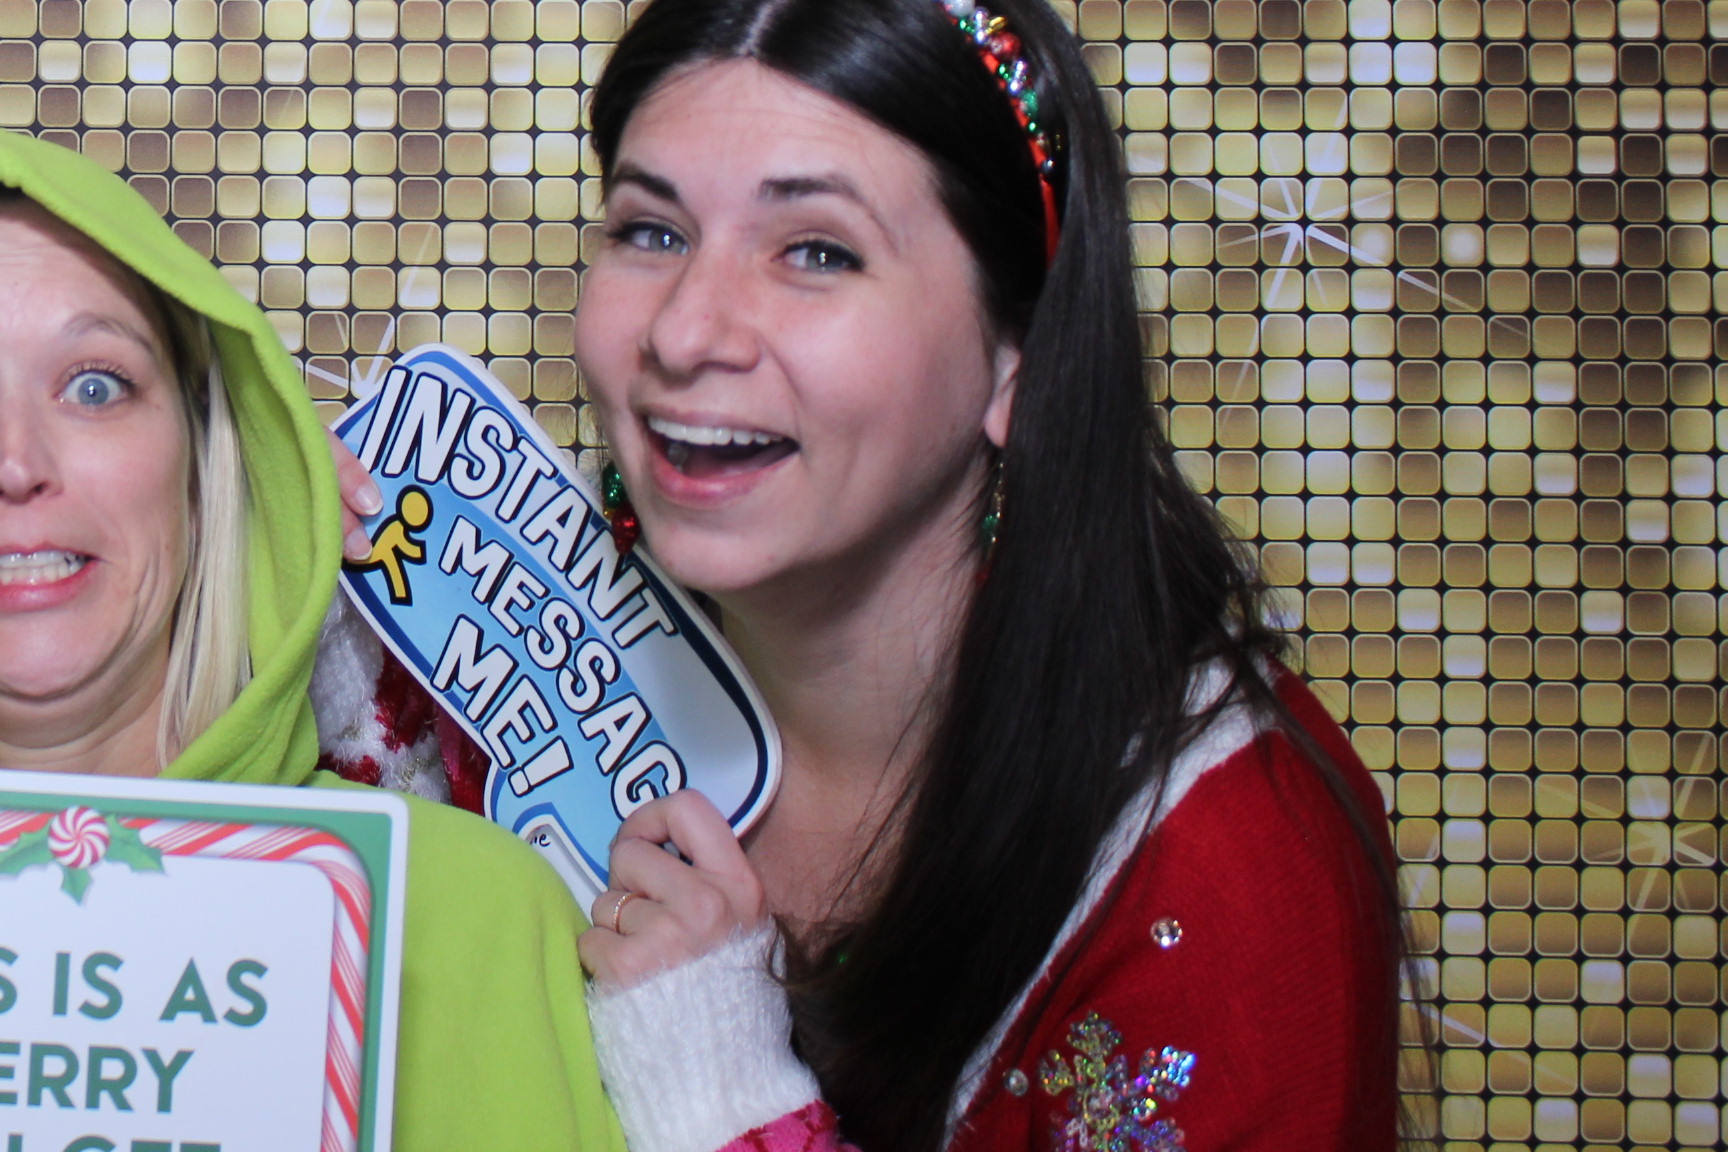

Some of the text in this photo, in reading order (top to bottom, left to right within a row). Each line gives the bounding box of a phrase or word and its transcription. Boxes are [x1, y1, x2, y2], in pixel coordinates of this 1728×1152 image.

[356, 365, 679, 649] INSTANT
[430, 614, 574, 798] ME!
[438, 515, 688, 823] MESSAG
[52, 951, 125, 1021] IS
[158, 957, 271, 1027] AS
